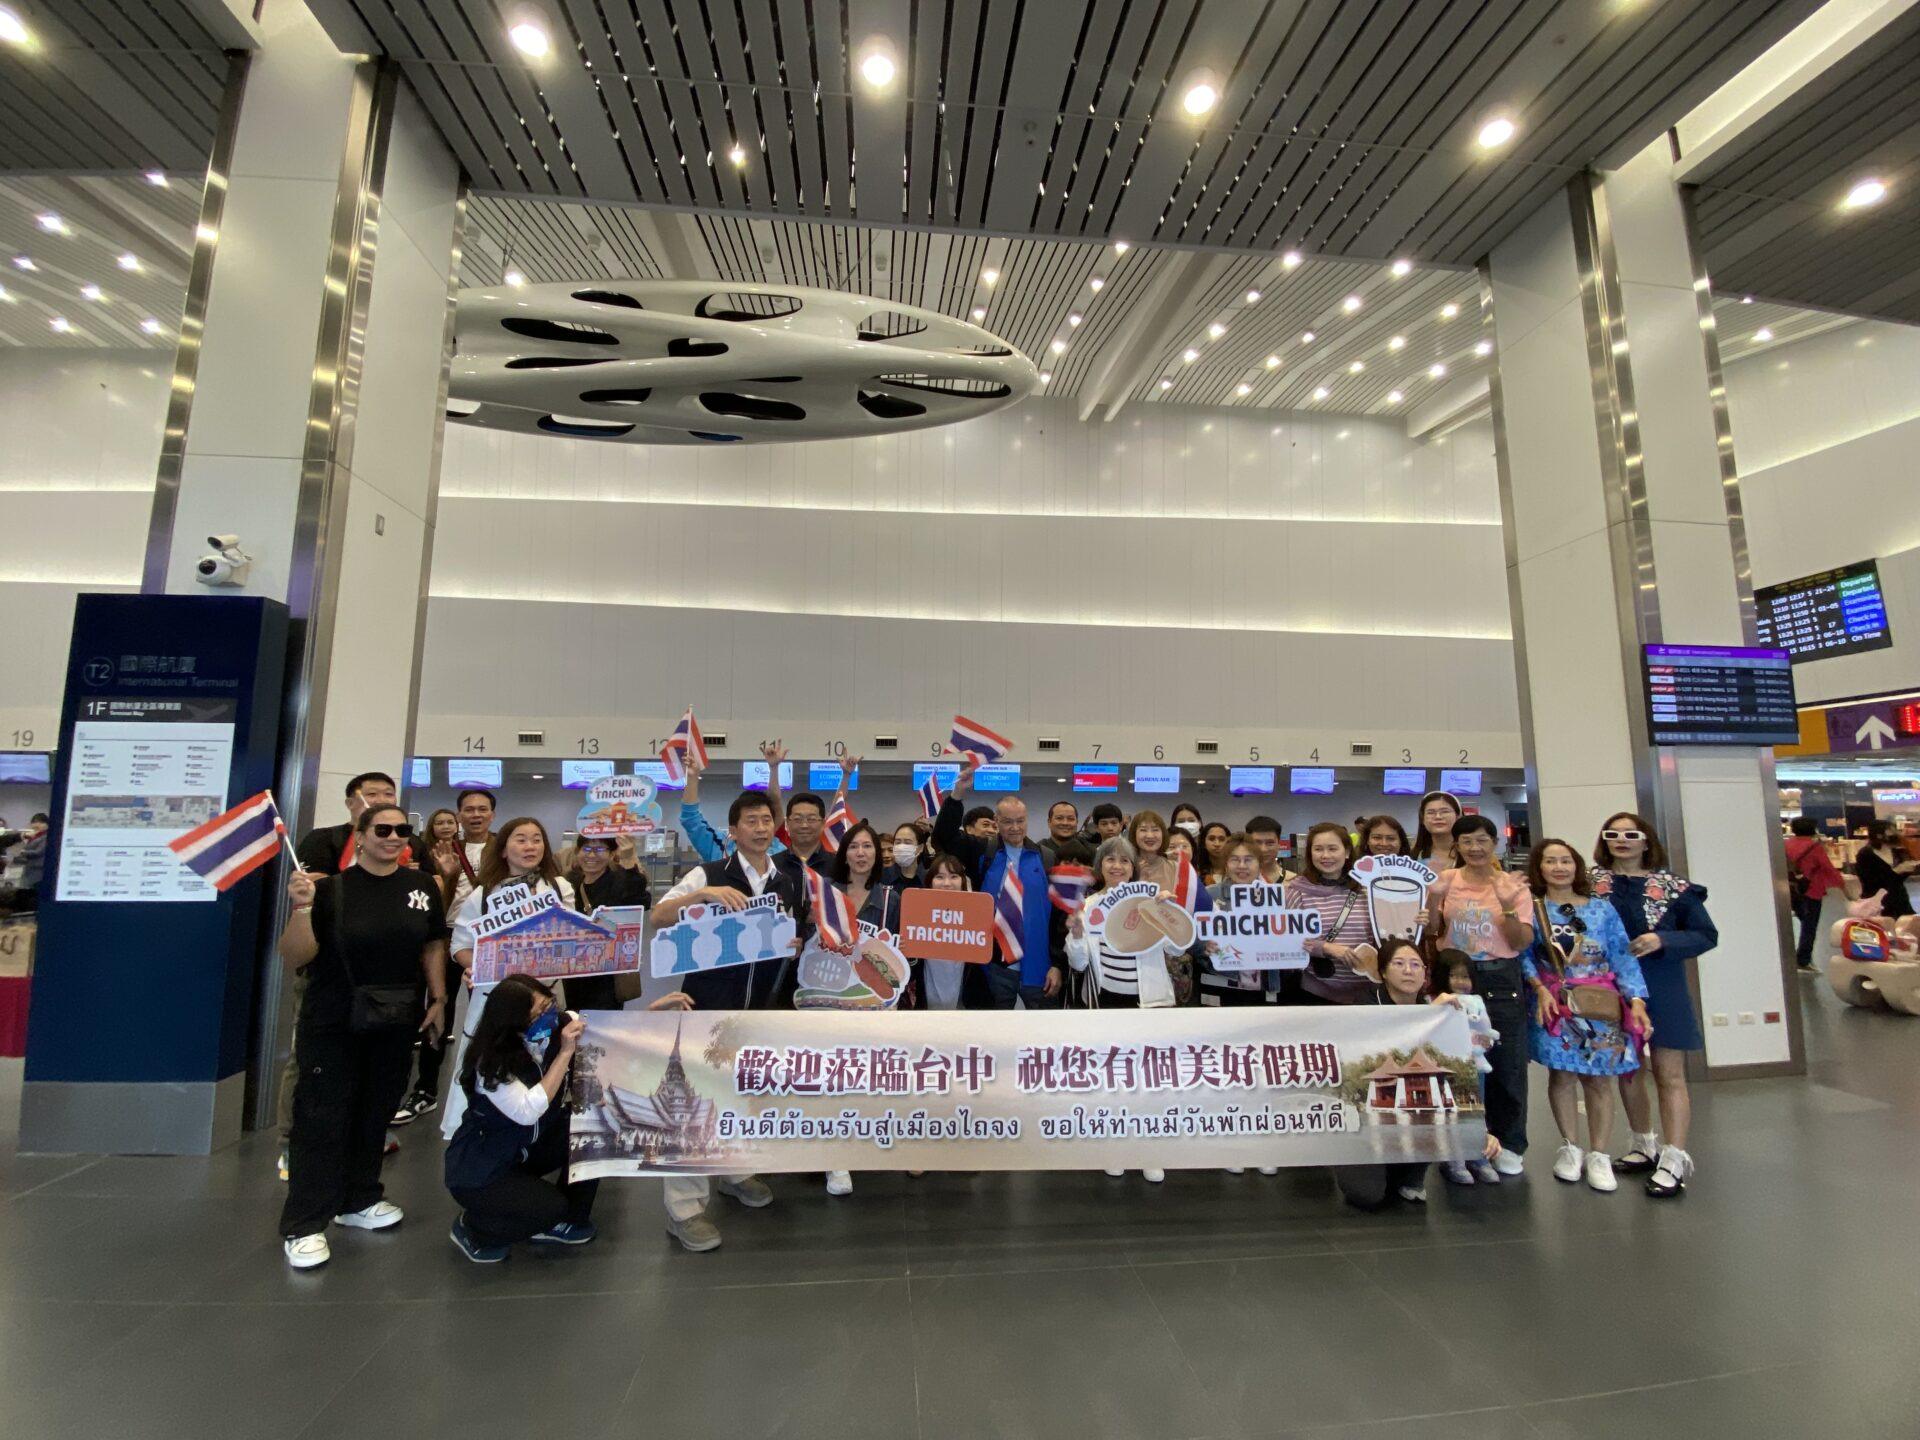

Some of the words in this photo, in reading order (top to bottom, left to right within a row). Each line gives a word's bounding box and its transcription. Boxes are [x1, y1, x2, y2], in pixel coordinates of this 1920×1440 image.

[1790, 601, 1807, 610] 11:54
[88, 664, 110, 679] T2
[87, 702, 107, 716] 1F
[12, 730, 34, 747] 19
[463, 737, 486, 753] 14
[577, 738, 599, 754] 13
[824, 740, 844, 757] 10
[931, 742, 942, 758] 9
[1091, 744, 1102, 760] 7
[1153, 745, 1164, 761] 6
[1249, 746, 1260, 762] 5
[1309, 747, 1320, 762] 4
[1401, 748, 1412, 764] 3
[1459, 749, 1469, 764] 2
[611, 779, 632, 788] FUN
[595, 787, 646, 800] TAICHUNG
[1375, 855, 1437, 882] Taichung
[407, 889, 430, 912] NY
[491, 887, 527, 910] FUN
[1099, 882, 1157, 910] Taichung
[1234, 884, 1282, 907] FUN
[471, 893, 556, 936] TAICHUNG
[680, 908, 685, 921] I
[932, 908, 963, 924] FUN
[1196, 913, 1320, 936] TAICHUNG
[906, 926, 986, 947] TAICHUNG
[736, 1047, 993, 1092] 歡迎蒞臨台中
[1018, 1043, 1341, 1090] 祝您有個美好假期
[719, 1109, 1018, 1145] ยินดีต้อนรับสู่เมืองไถจง
